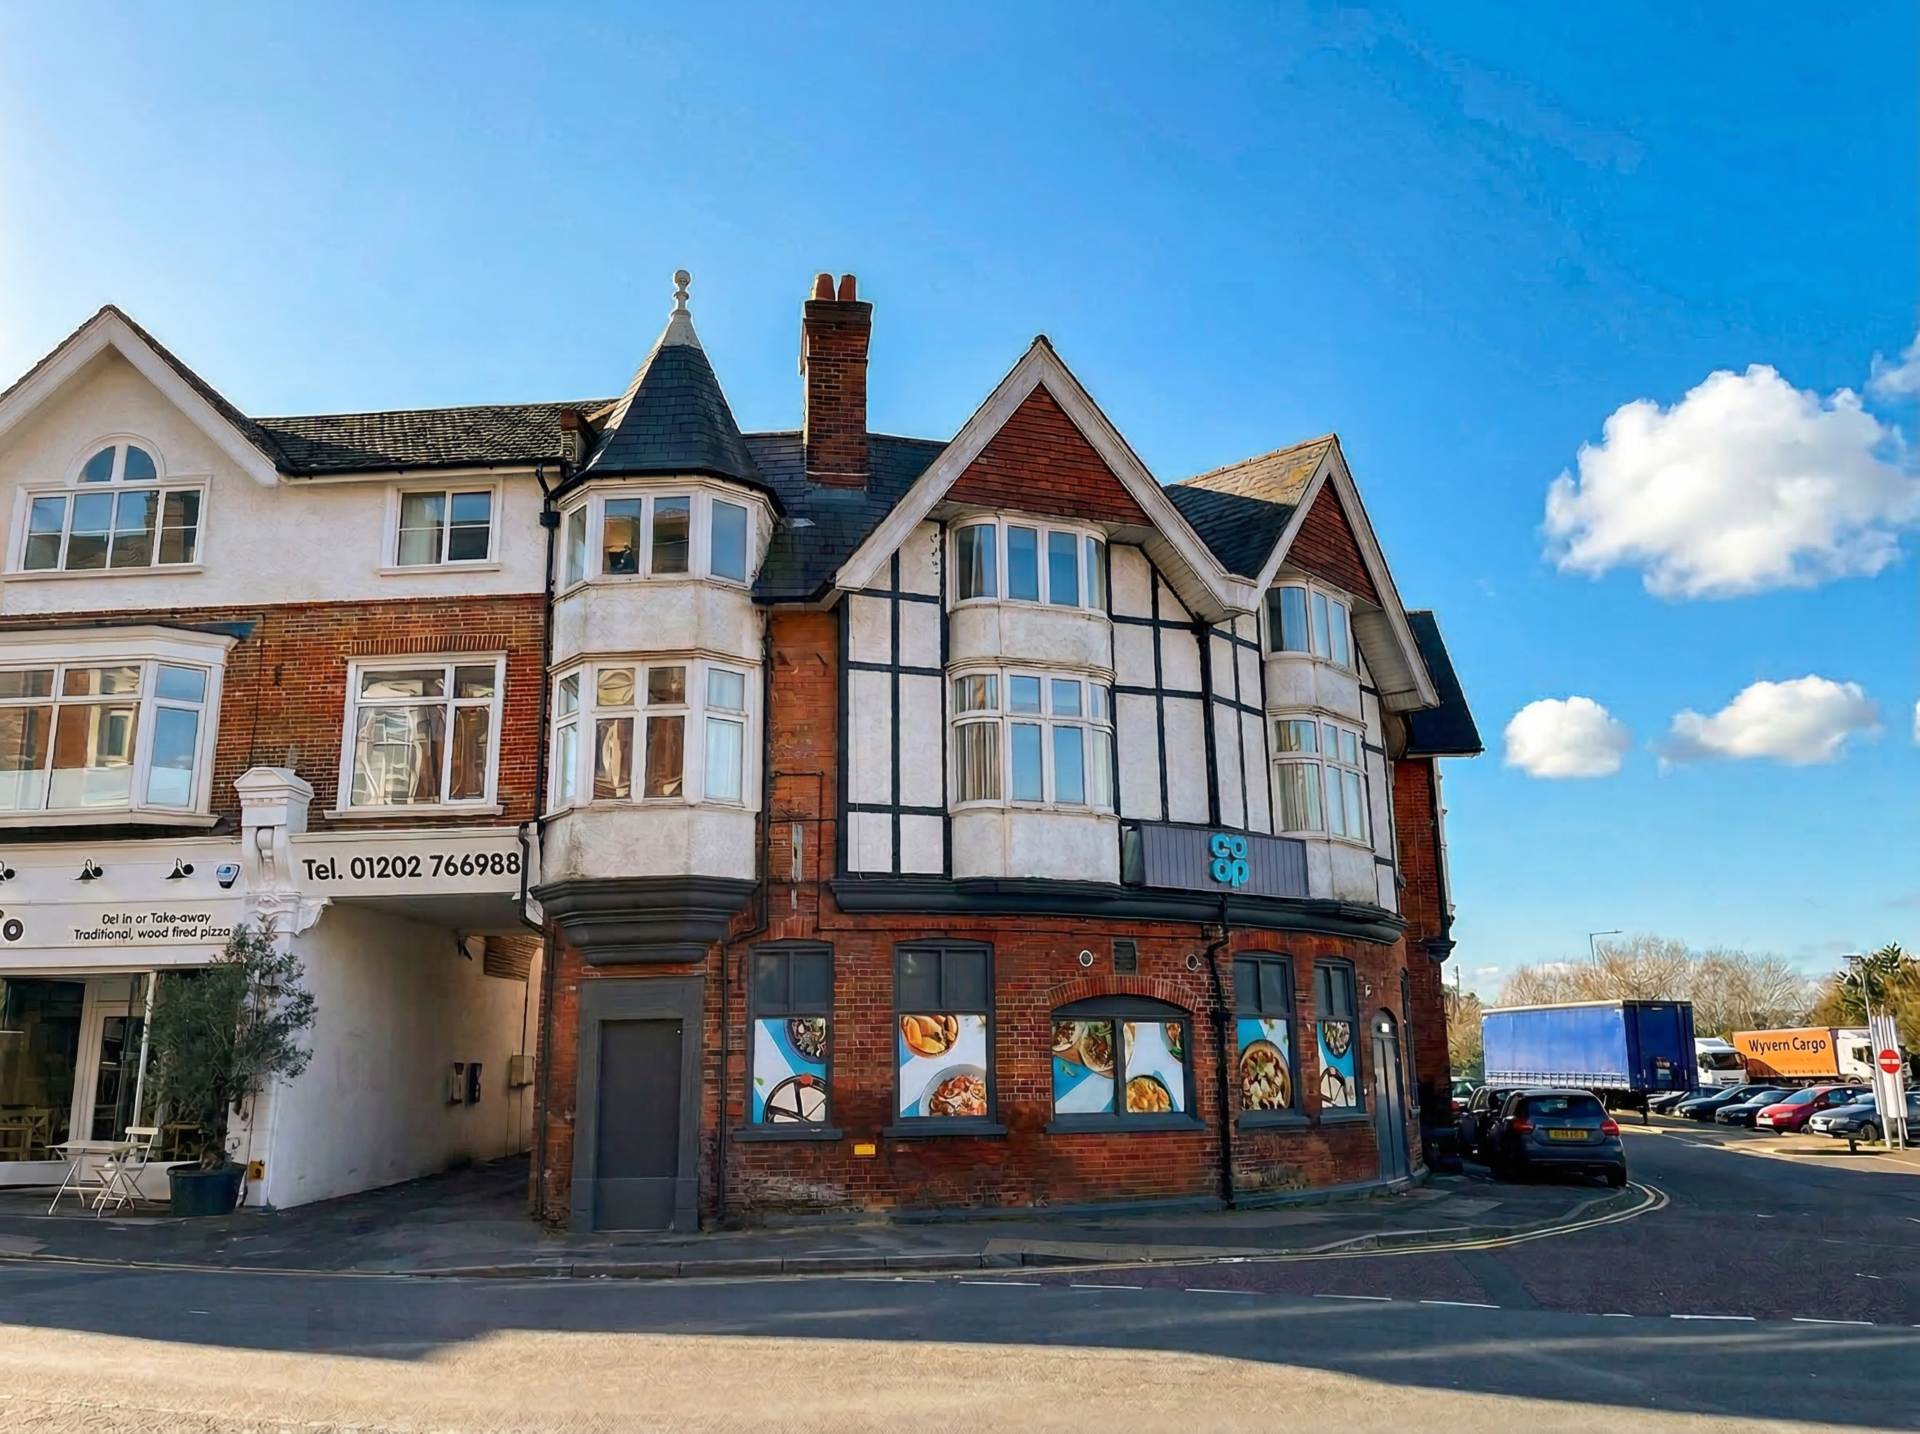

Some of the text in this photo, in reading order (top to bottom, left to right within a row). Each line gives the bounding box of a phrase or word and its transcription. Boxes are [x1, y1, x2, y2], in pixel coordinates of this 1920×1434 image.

[302, 852, 521, 880] Tel. 01202 766988
[135, 915, 148, 924] or
[150, 912, 211, 925] Take-away
[74, 926, 231, 941] Traditional, wood fired pizza
[1748, 1036, 1826, 1056] Wyvern Cargo
